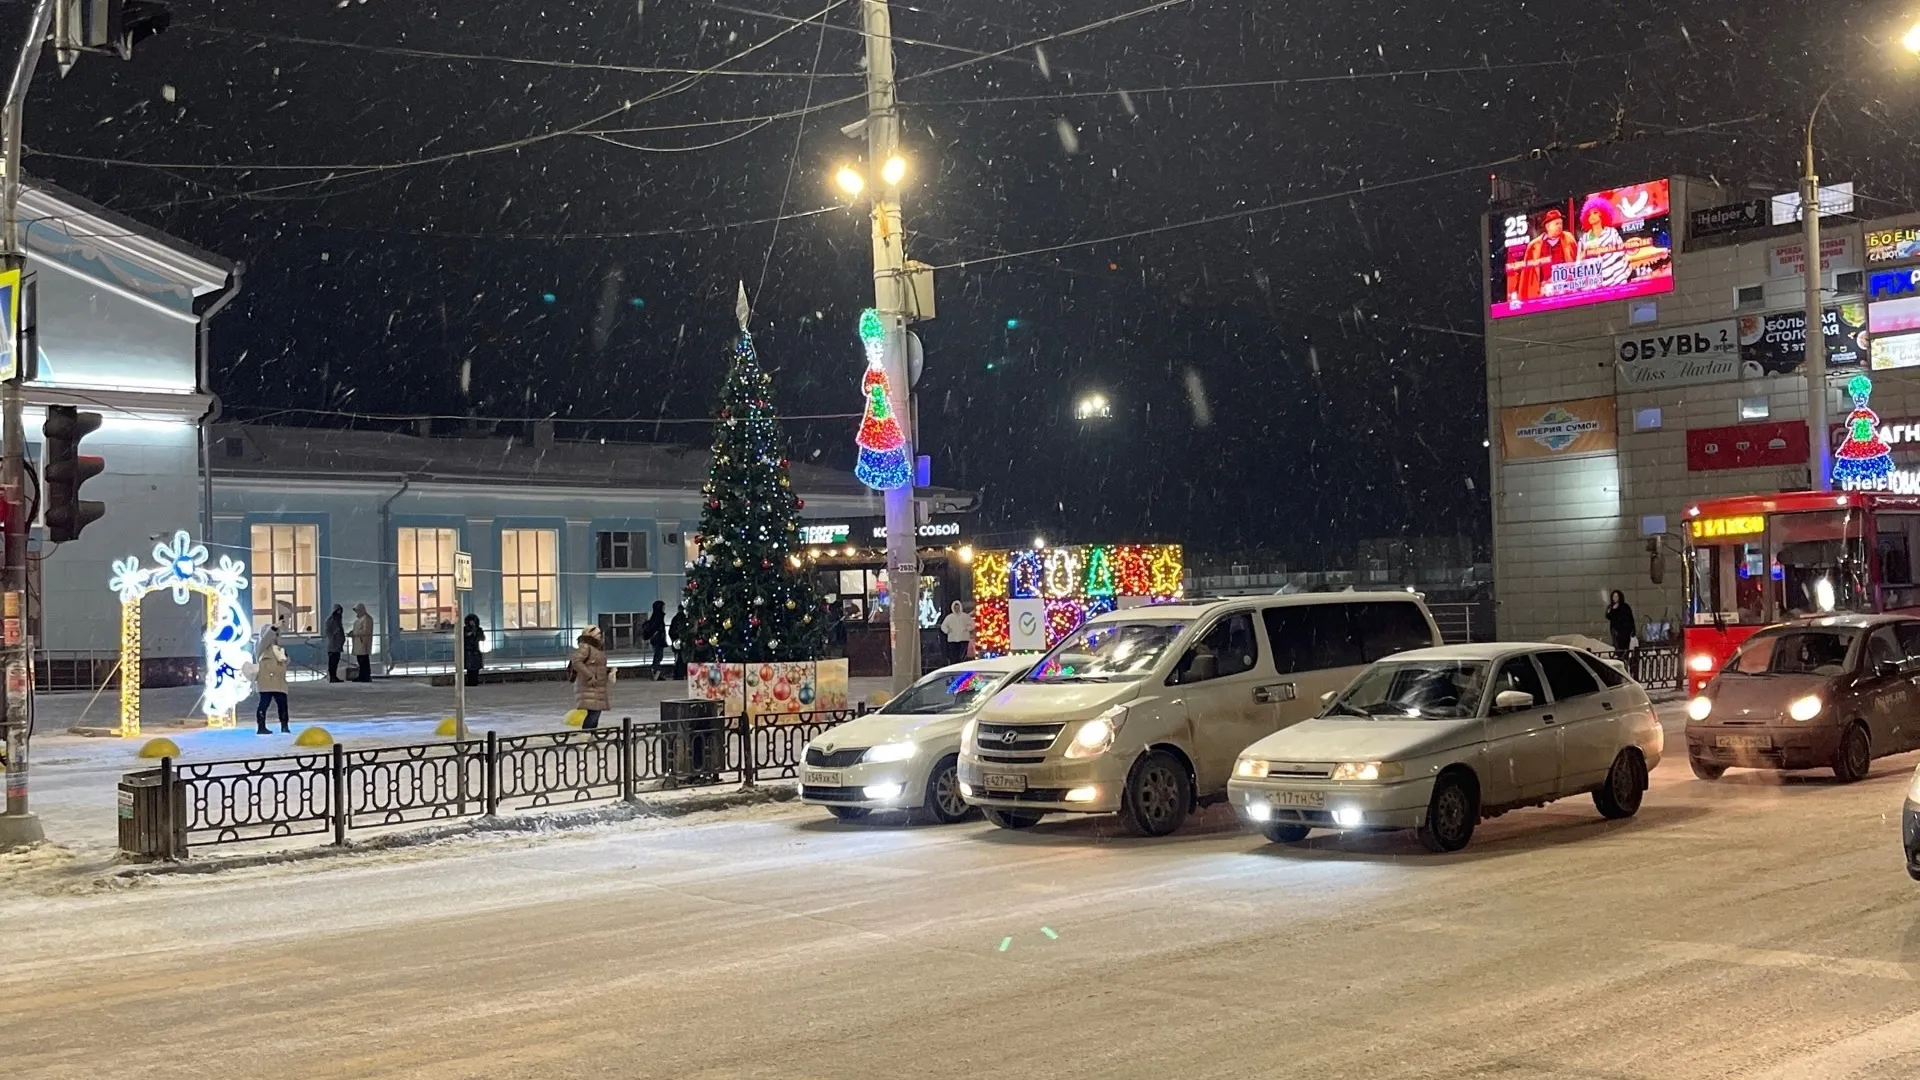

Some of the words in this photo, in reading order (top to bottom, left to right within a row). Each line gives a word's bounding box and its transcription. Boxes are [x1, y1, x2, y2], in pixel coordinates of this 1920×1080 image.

[1698, 208, 1741, 225] iHelper
[1504, 214, 1528, 238] 25
[1552, 262, 1602, 282] ПОЧЕМУ
[1767, 312, 1837, 331] БОЛЬАЯ
[1720, 329, 1728, 342] 2
[1766, 324, 1840, 343] СТОЛАЯ
[1620, 332, 1711, 362] ОБУВЬ
[1781, 343, 1789, 353] 3
[1517, 425, 1562, 437] ИМПЕРИЯ
[919, 522, 960, 537] СОБОЙ
